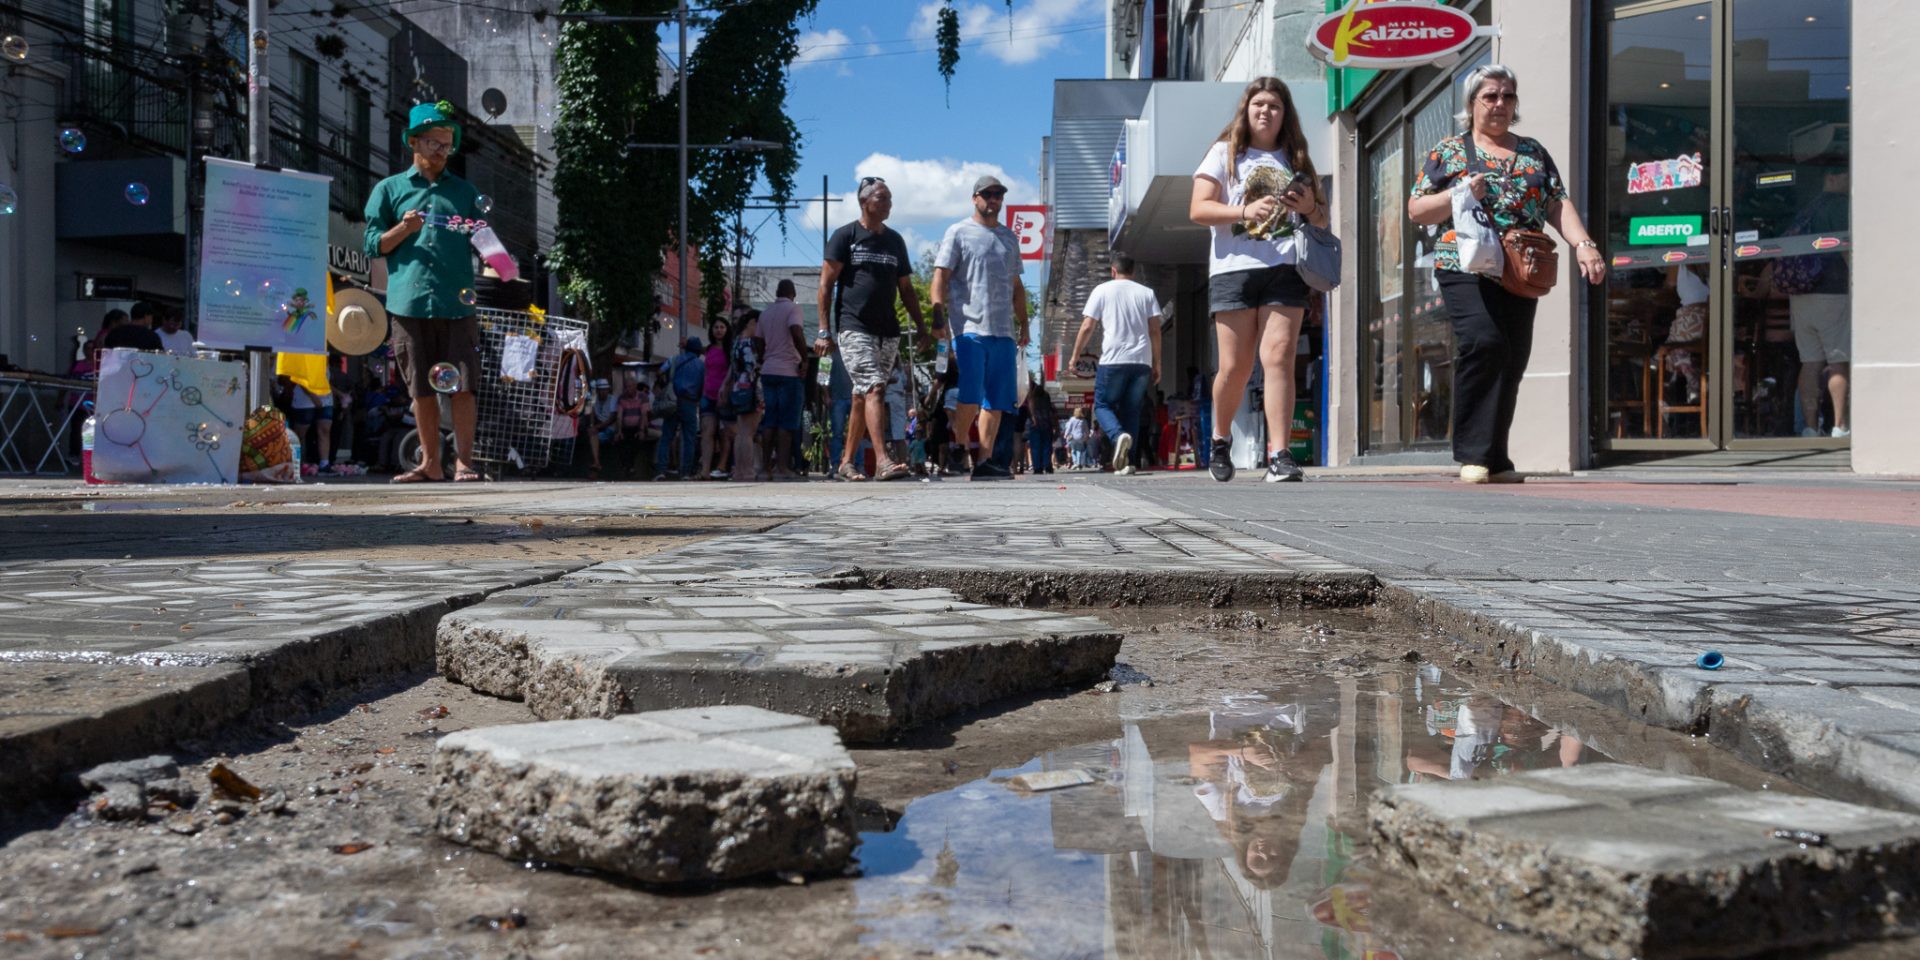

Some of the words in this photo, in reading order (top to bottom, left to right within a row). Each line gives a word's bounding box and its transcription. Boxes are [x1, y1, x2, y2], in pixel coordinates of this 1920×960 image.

[1333, 0, 1455, 62] Kalzone
[1388, 20, 1425, 28] MINI
[1629, 173, 1683, 192] NATAL
[1012, 211, 1045, 254] B
[1637, 223, 1694, 237] ABERTO
